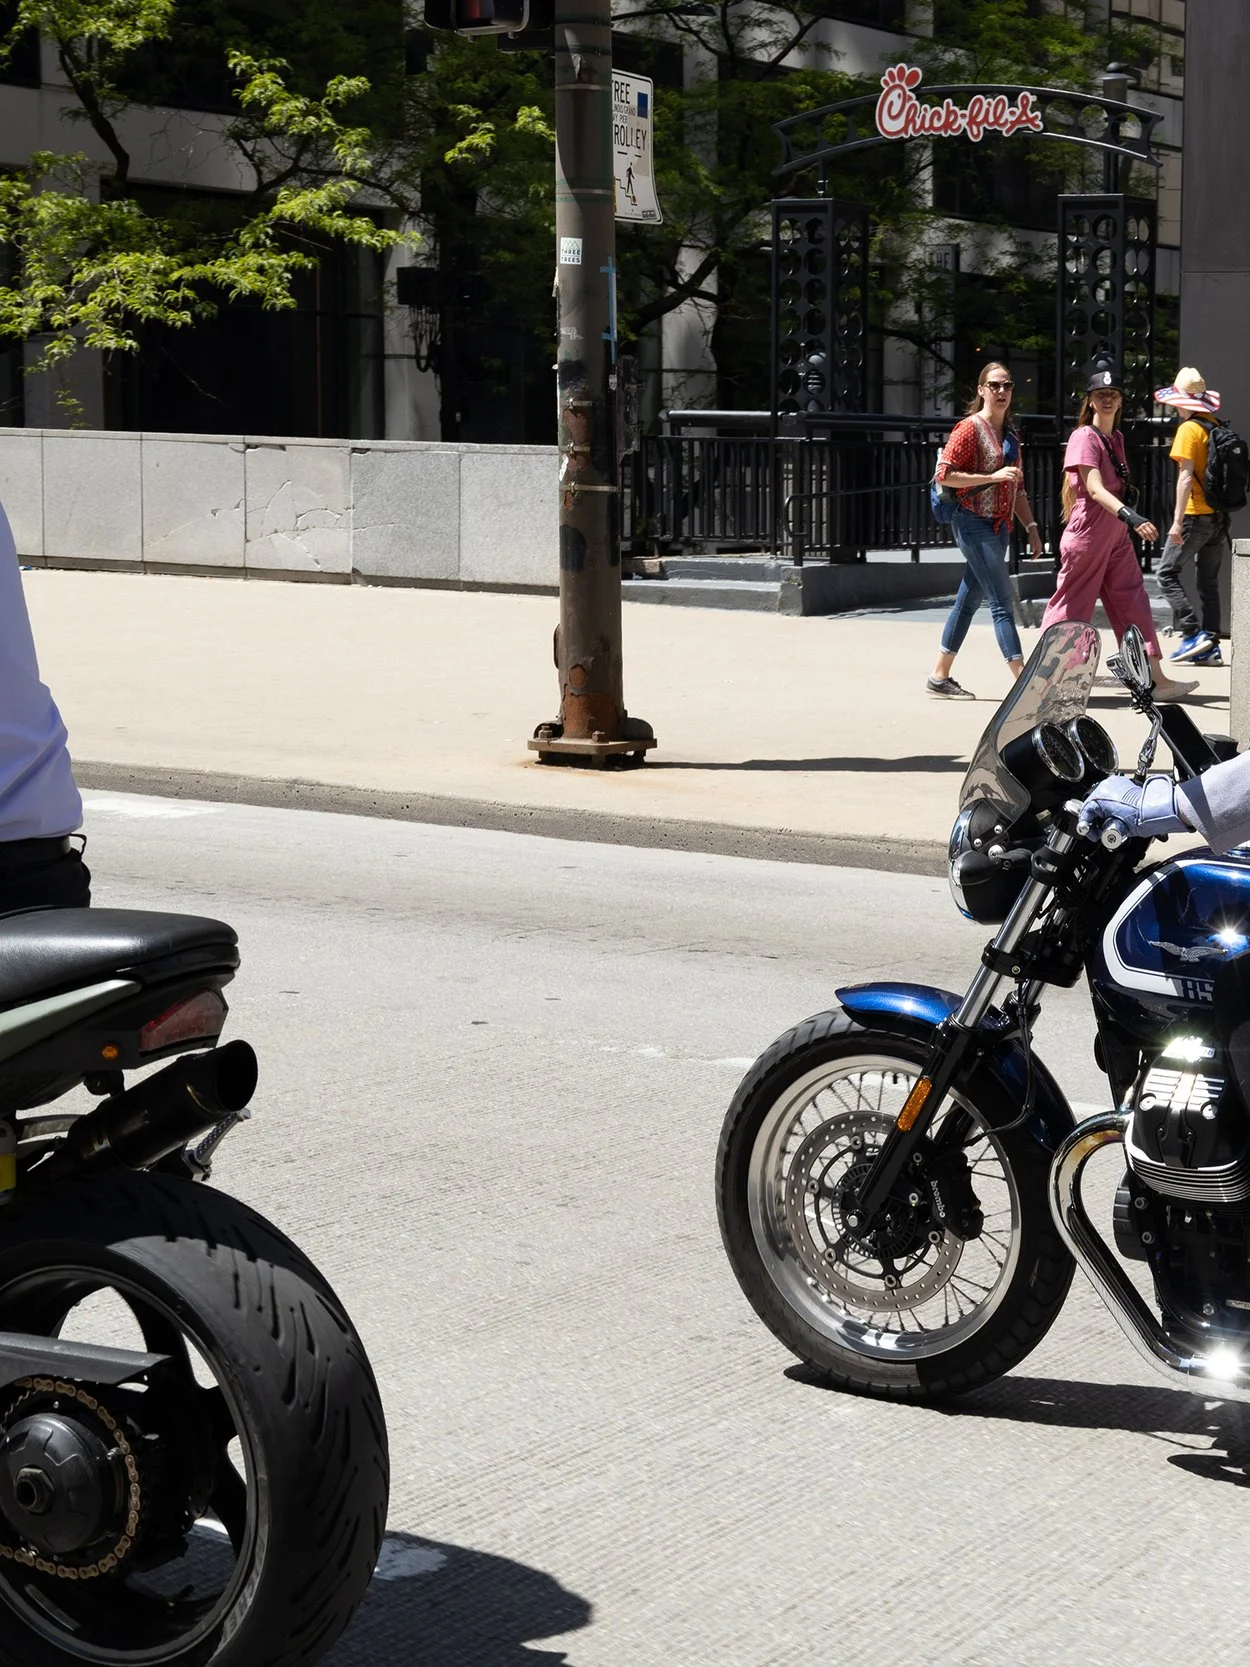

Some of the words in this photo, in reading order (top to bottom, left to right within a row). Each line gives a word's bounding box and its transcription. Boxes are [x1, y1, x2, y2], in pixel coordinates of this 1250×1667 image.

[612, 80, 631, 104] REE
[877, 80, 1041, 141] Chick-fil-A
[613, 123, 647, 151] ROLLEY
[930, 1180, 946, 1218] brembo
